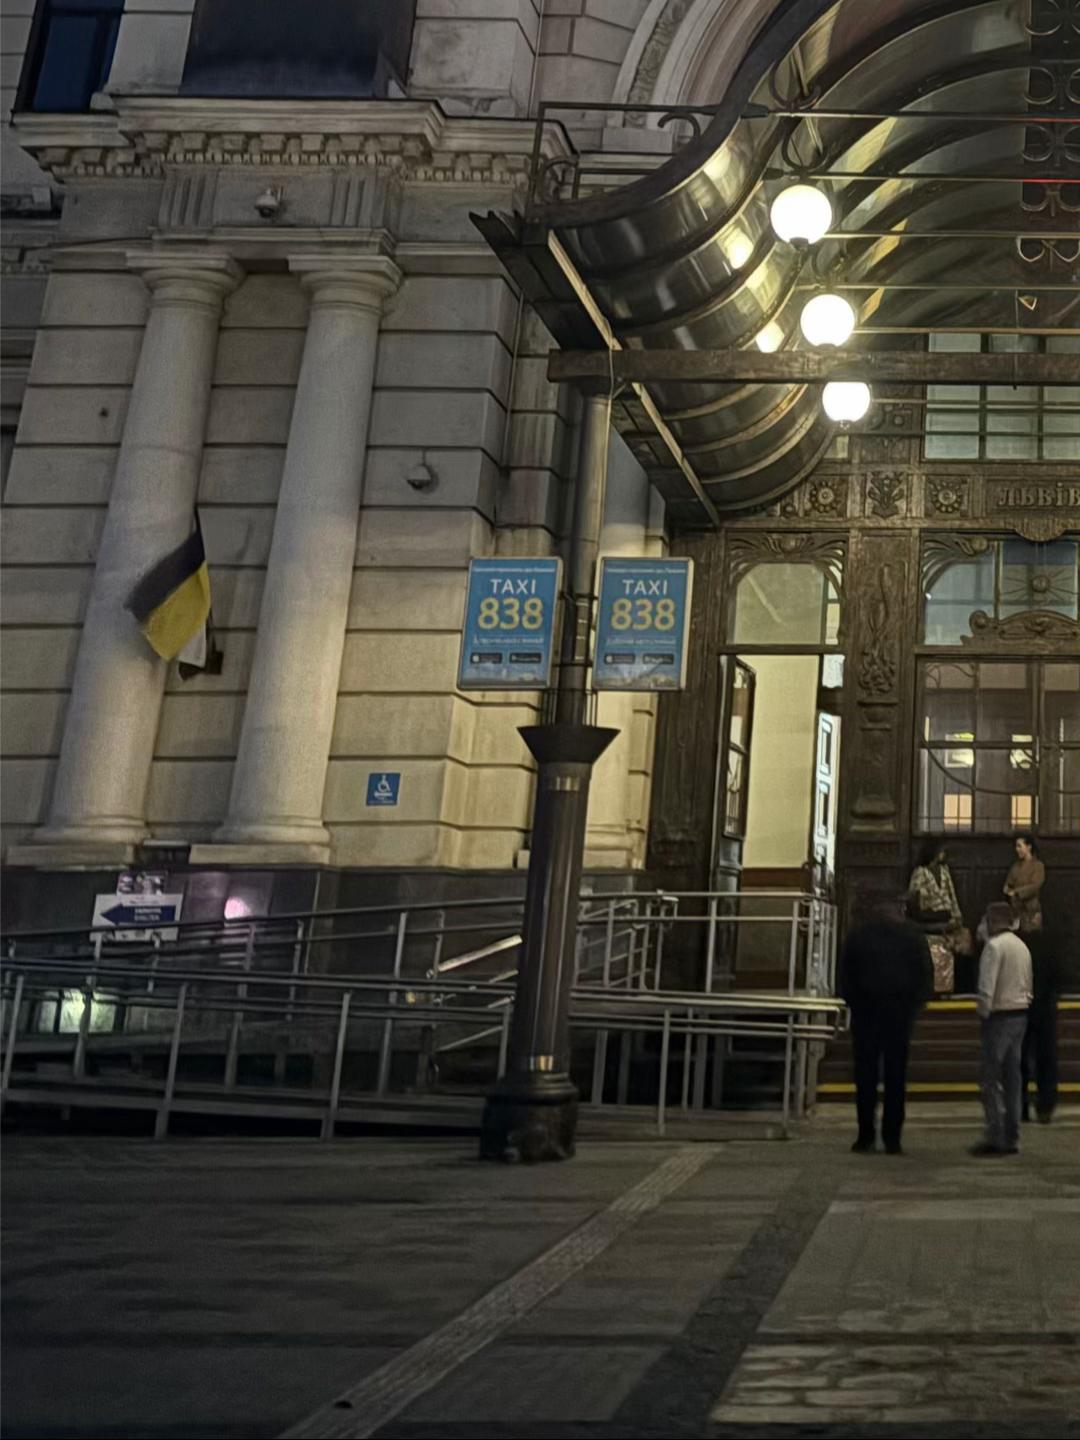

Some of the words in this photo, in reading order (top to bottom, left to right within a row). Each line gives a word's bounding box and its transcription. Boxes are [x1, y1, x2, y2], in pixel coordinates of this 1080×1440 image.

[490, 579, 536, 594] TAXI
[622, 579, 668, 595] TAXI
[478, 597, 544, 630] 838
[610, 598, 675, 631] 838
